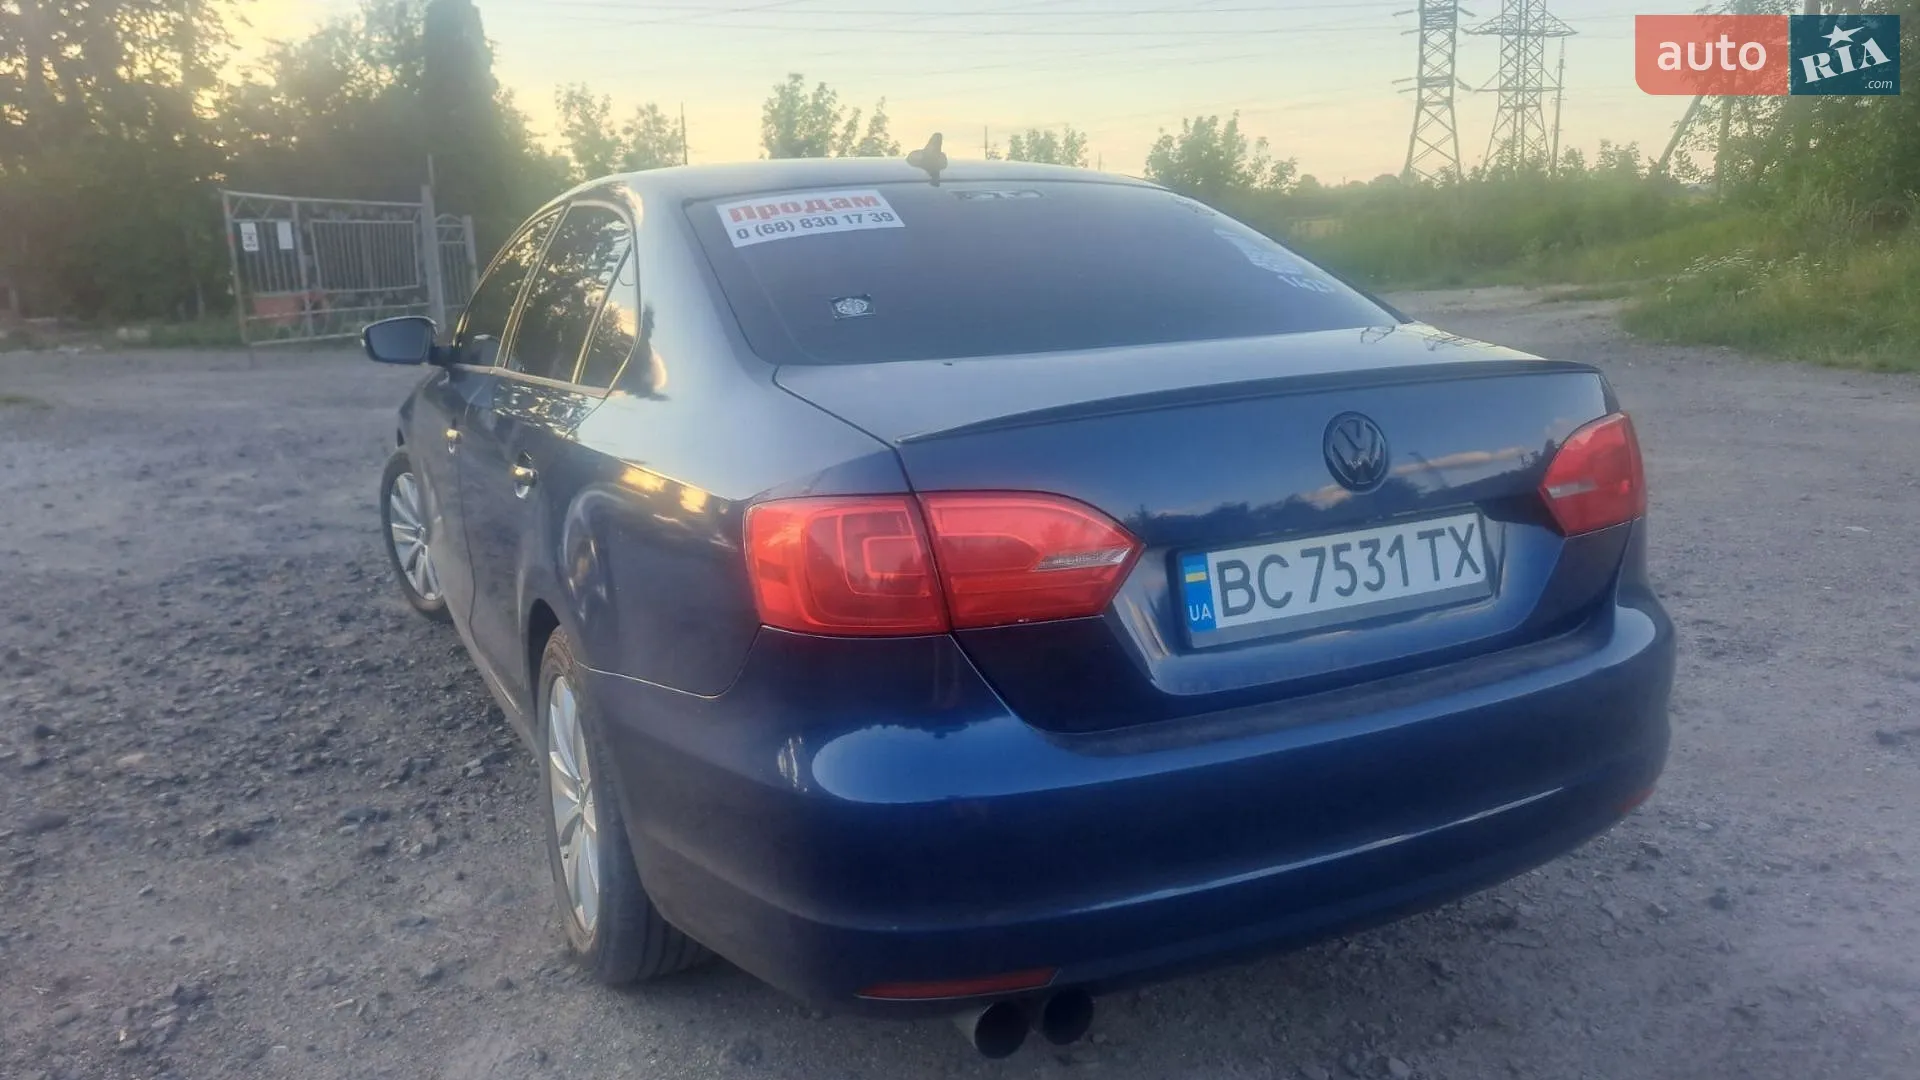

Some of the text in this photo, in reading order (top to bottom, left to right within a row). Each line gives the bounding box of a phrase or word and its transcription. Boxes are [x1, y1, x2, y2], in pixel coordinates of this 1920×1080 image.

[736, 211, 895, 240] 0 (68) 830 17 39
[1188, 602, 1213, 622] UA
